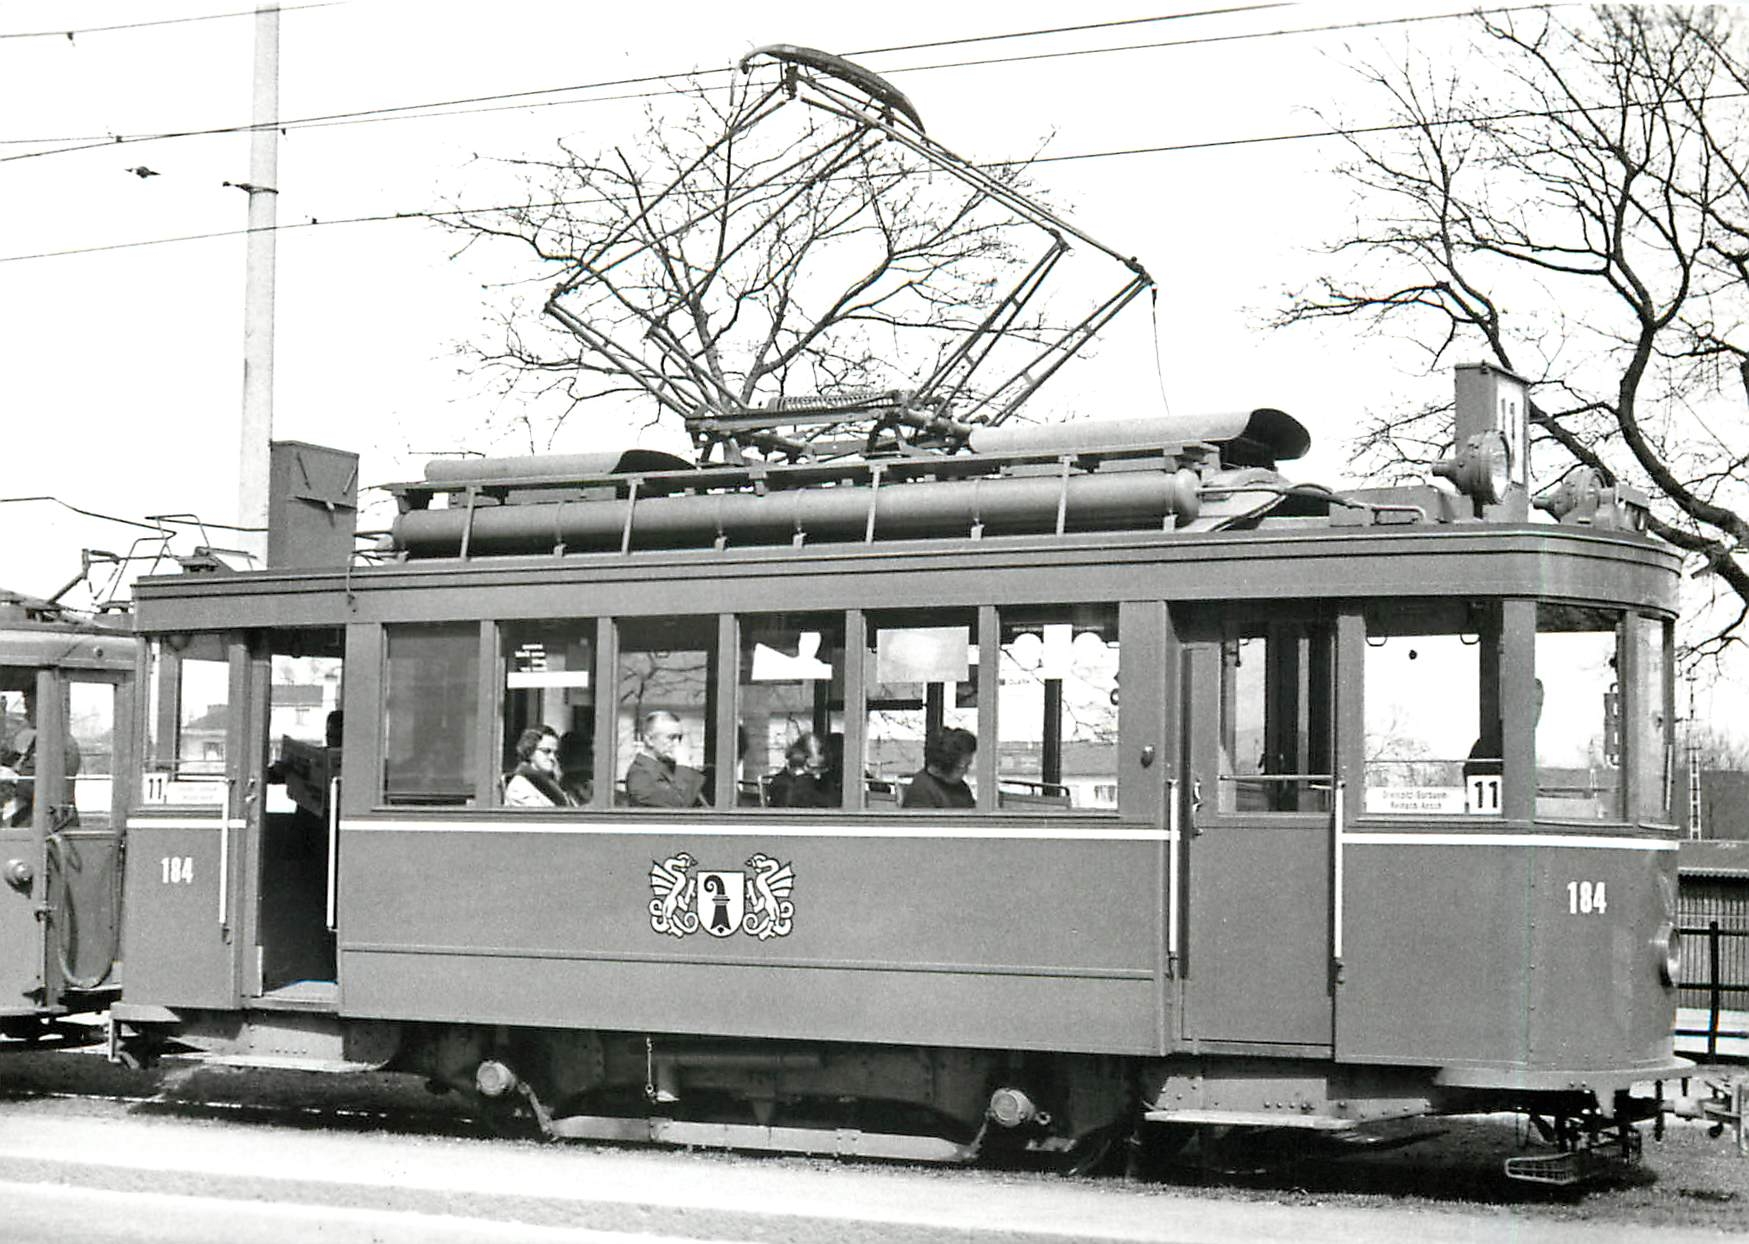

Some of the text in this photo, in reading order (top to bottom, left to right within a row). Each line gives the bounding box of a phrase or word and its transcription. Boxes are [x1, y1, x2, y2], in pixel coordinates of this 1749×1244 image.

[148, 778, 163, 800] 11
[1474, 780, 1499, 809] 11
[160, 856, 194, 884] 184
[1567, 881, 1608, 915] 184
